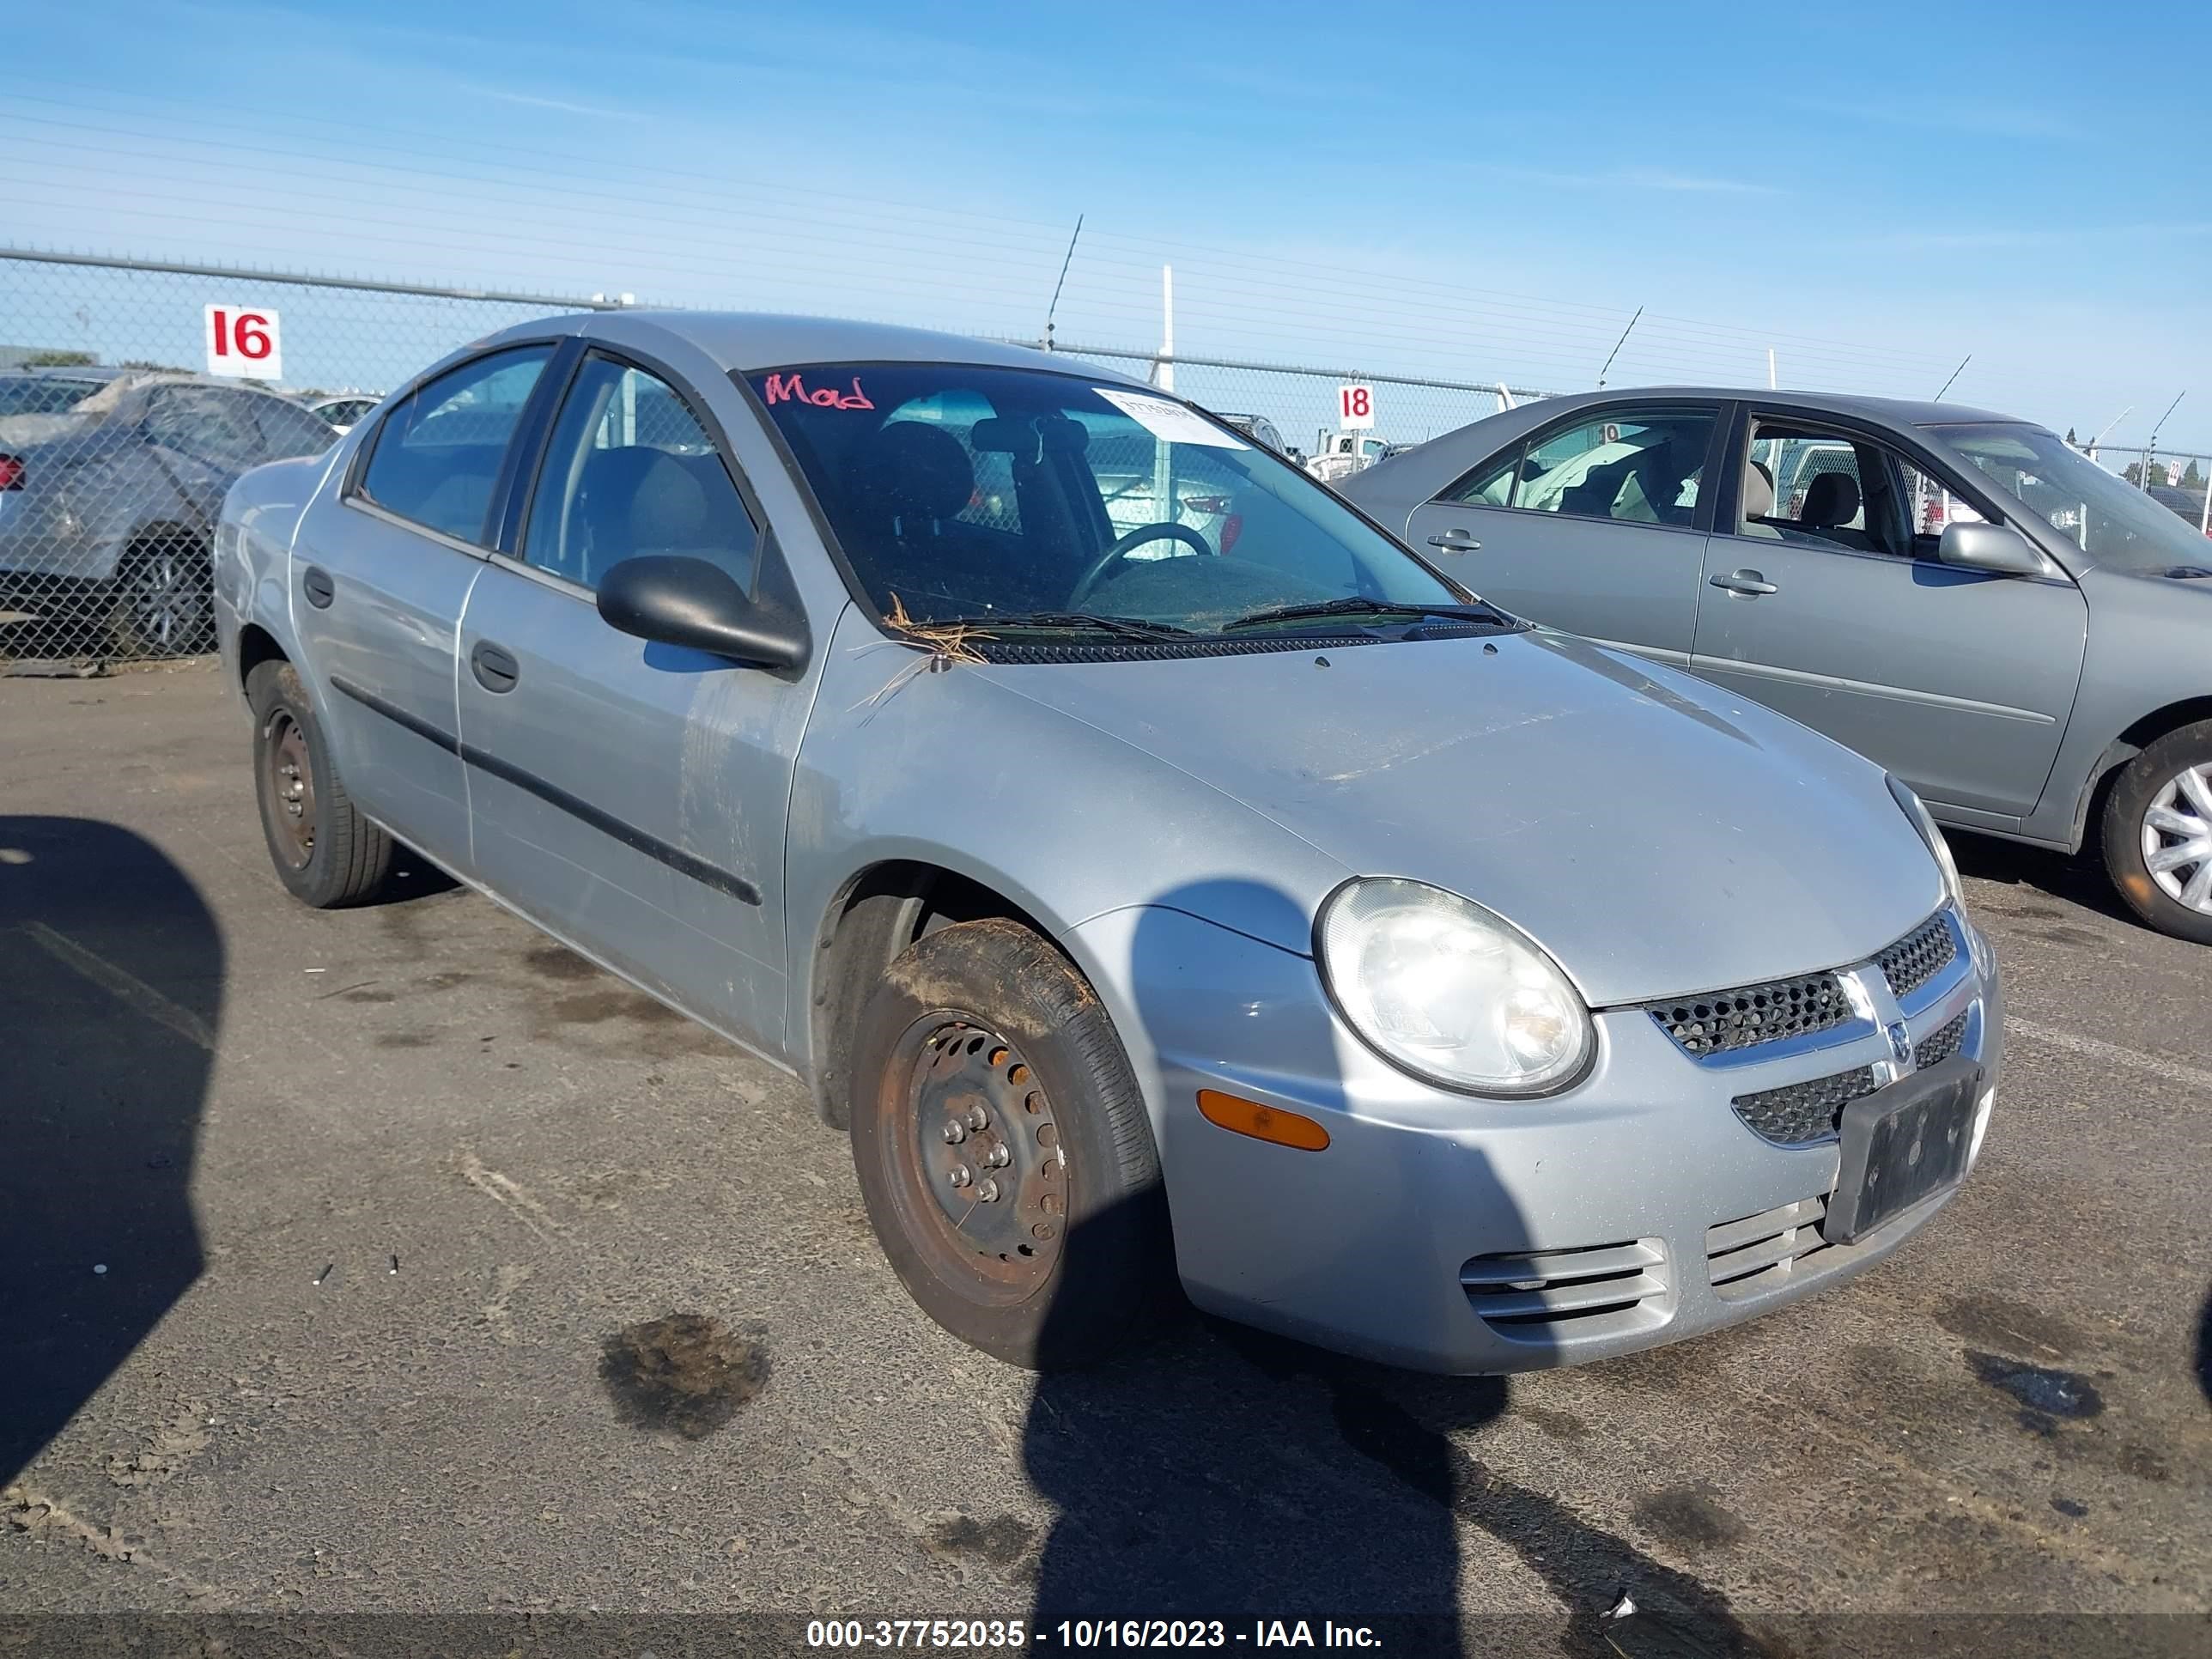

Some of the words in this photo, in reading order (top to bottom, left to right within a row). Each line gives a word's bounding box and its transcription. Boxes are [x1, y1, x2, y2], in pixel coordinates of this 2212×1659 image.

[213, 311, 271, 359] 16
[1343, 388, 1370, 417] 18
[2170, 462, 2179, 479] 22
